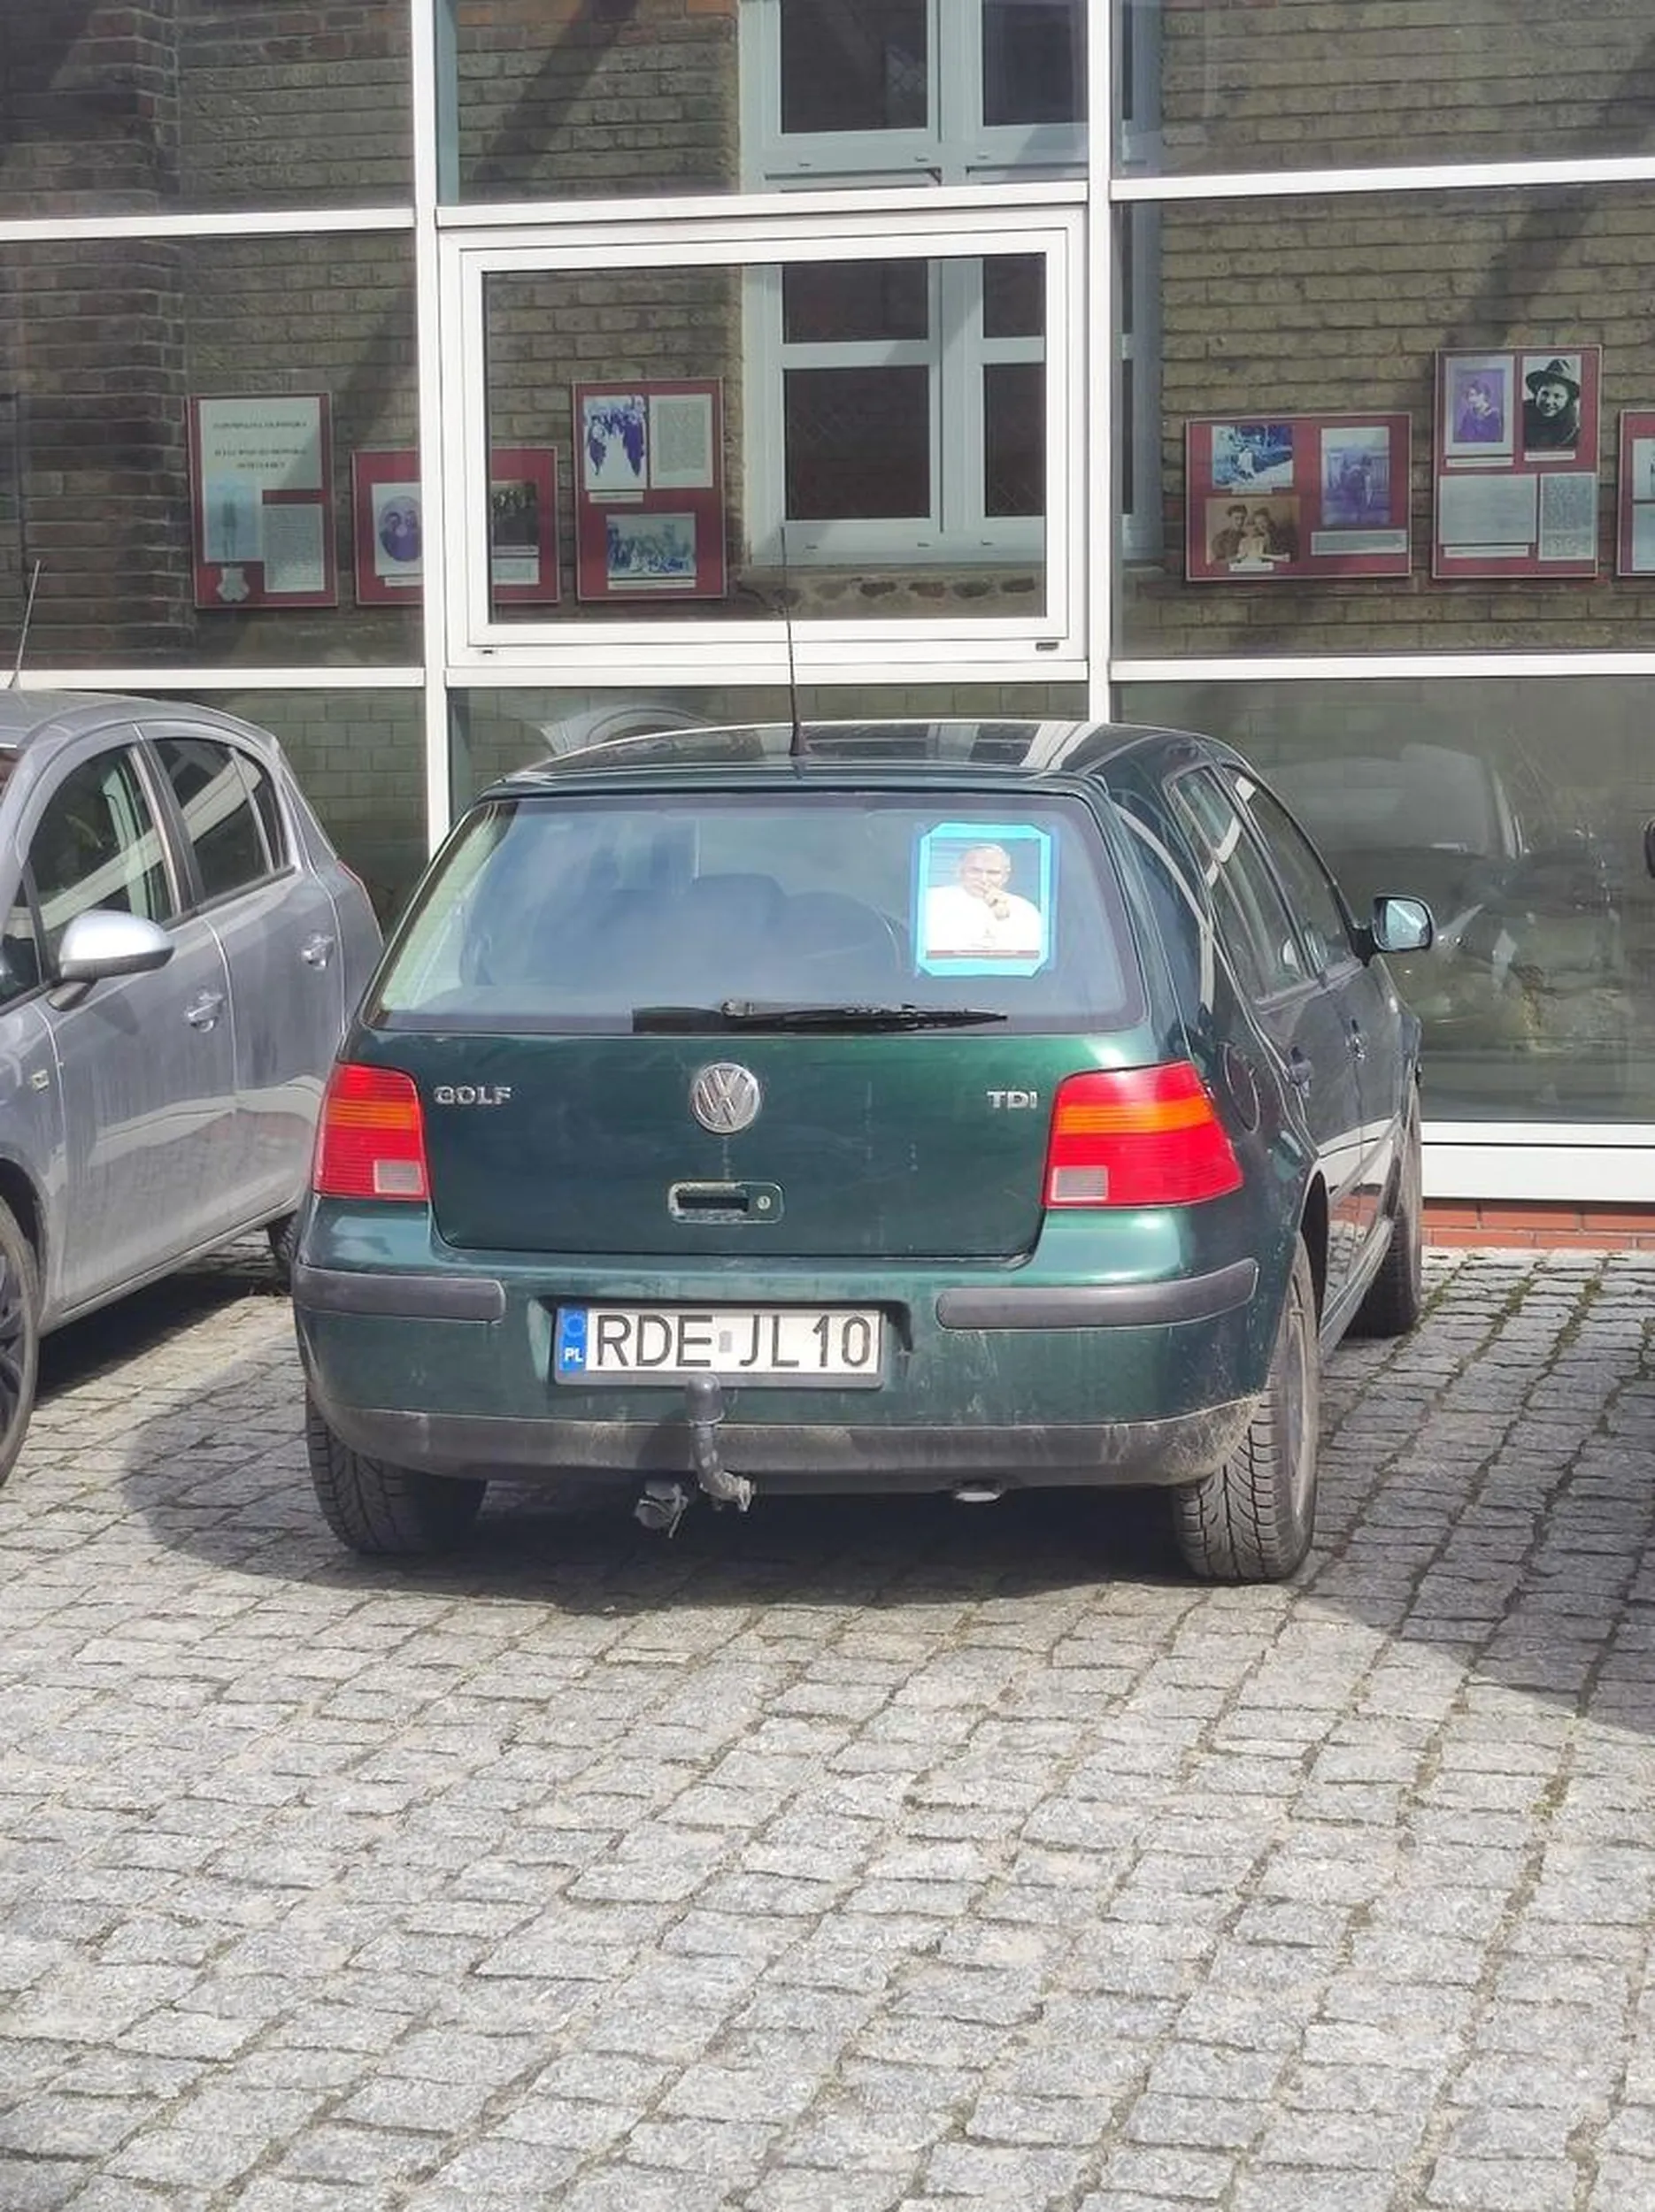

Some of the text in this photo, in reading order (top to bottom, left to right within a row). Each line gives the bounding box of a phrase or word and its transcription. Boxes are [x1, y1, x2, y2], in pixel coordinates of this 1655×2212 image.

[434, 1085, 512, 1105] GOLF
[986, 1090, 1038, 1109] TDI
[597, 1313, 871, 1368] RDE JL10
[564, 1348, 583, 1363] PL
